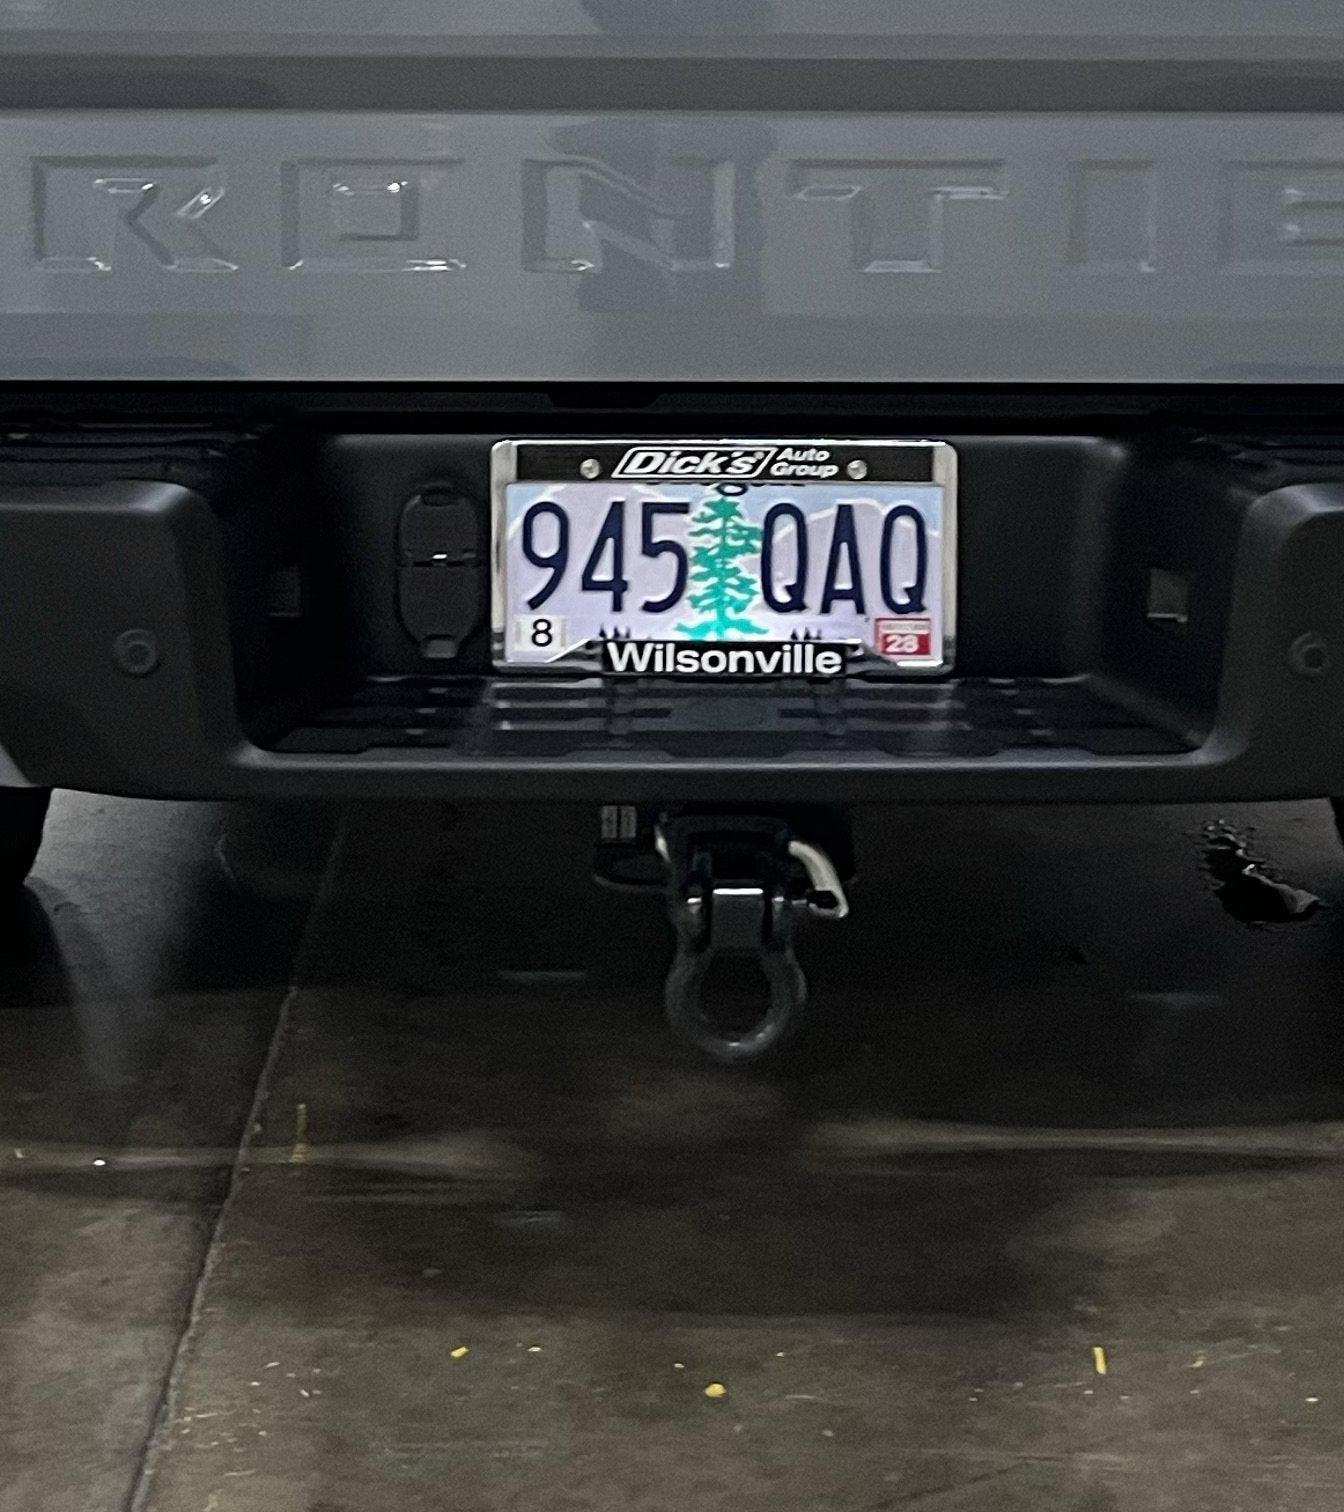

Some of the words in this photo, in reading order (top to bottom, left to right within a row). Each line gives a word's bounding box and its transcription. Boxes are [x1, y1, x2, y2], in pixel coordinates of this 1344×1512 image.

[776, 447, 831, 462] Auto
[770, 462, 840, 479] Group
[520, 500, 691, 614] 945
[760, 502, 928, 616] QAQ
[530, 617, 554, 648] 8
[606, 641, 843, 674] Wilsonville
